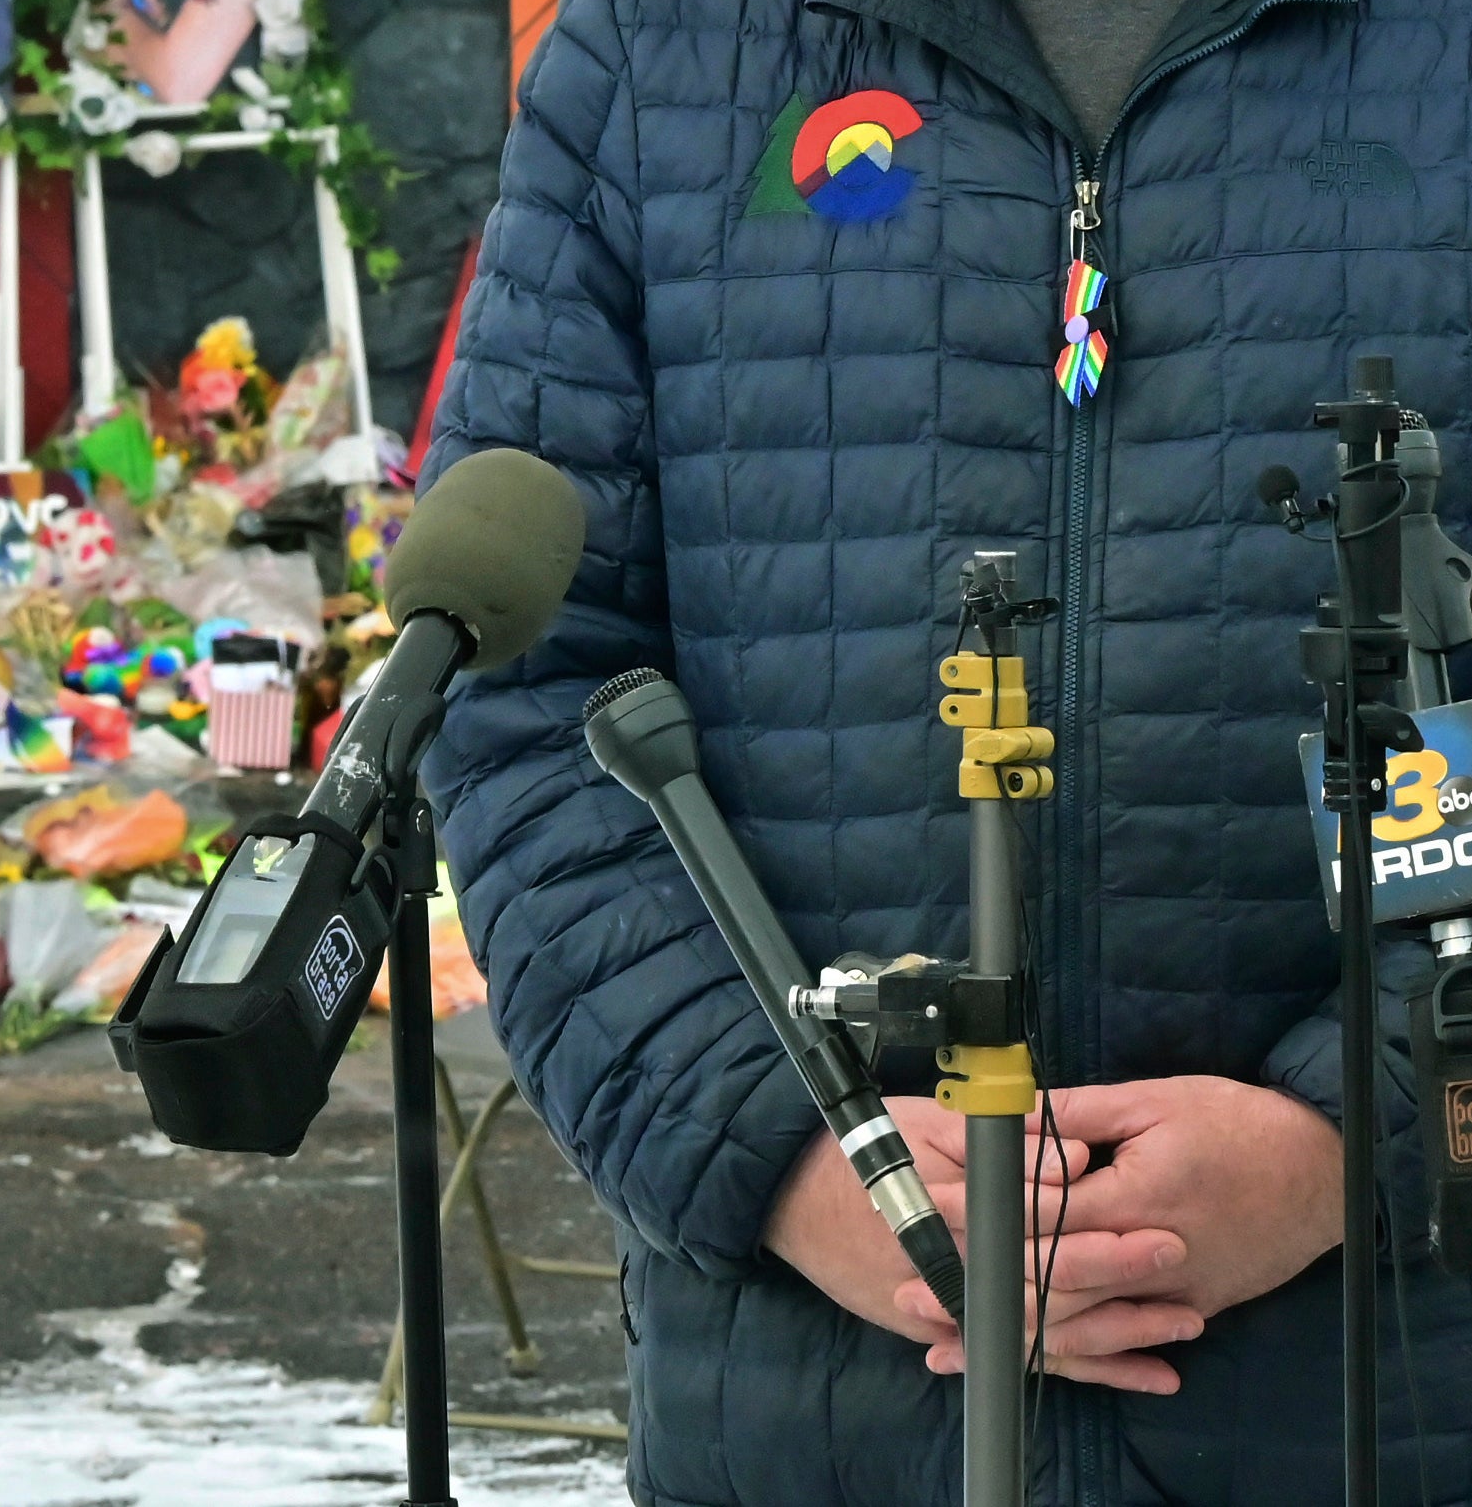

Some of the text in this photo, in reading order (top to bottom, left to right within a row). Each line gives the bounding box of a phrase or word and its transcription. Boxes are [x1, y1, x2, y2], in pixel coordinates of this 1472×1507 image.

[1287, 155, 1374, 179] NORTH
[1310, 177, 1373, 197] FACE
[1337, 749, 1447, 853] 3
[309, 956, 336, 1010] brace
